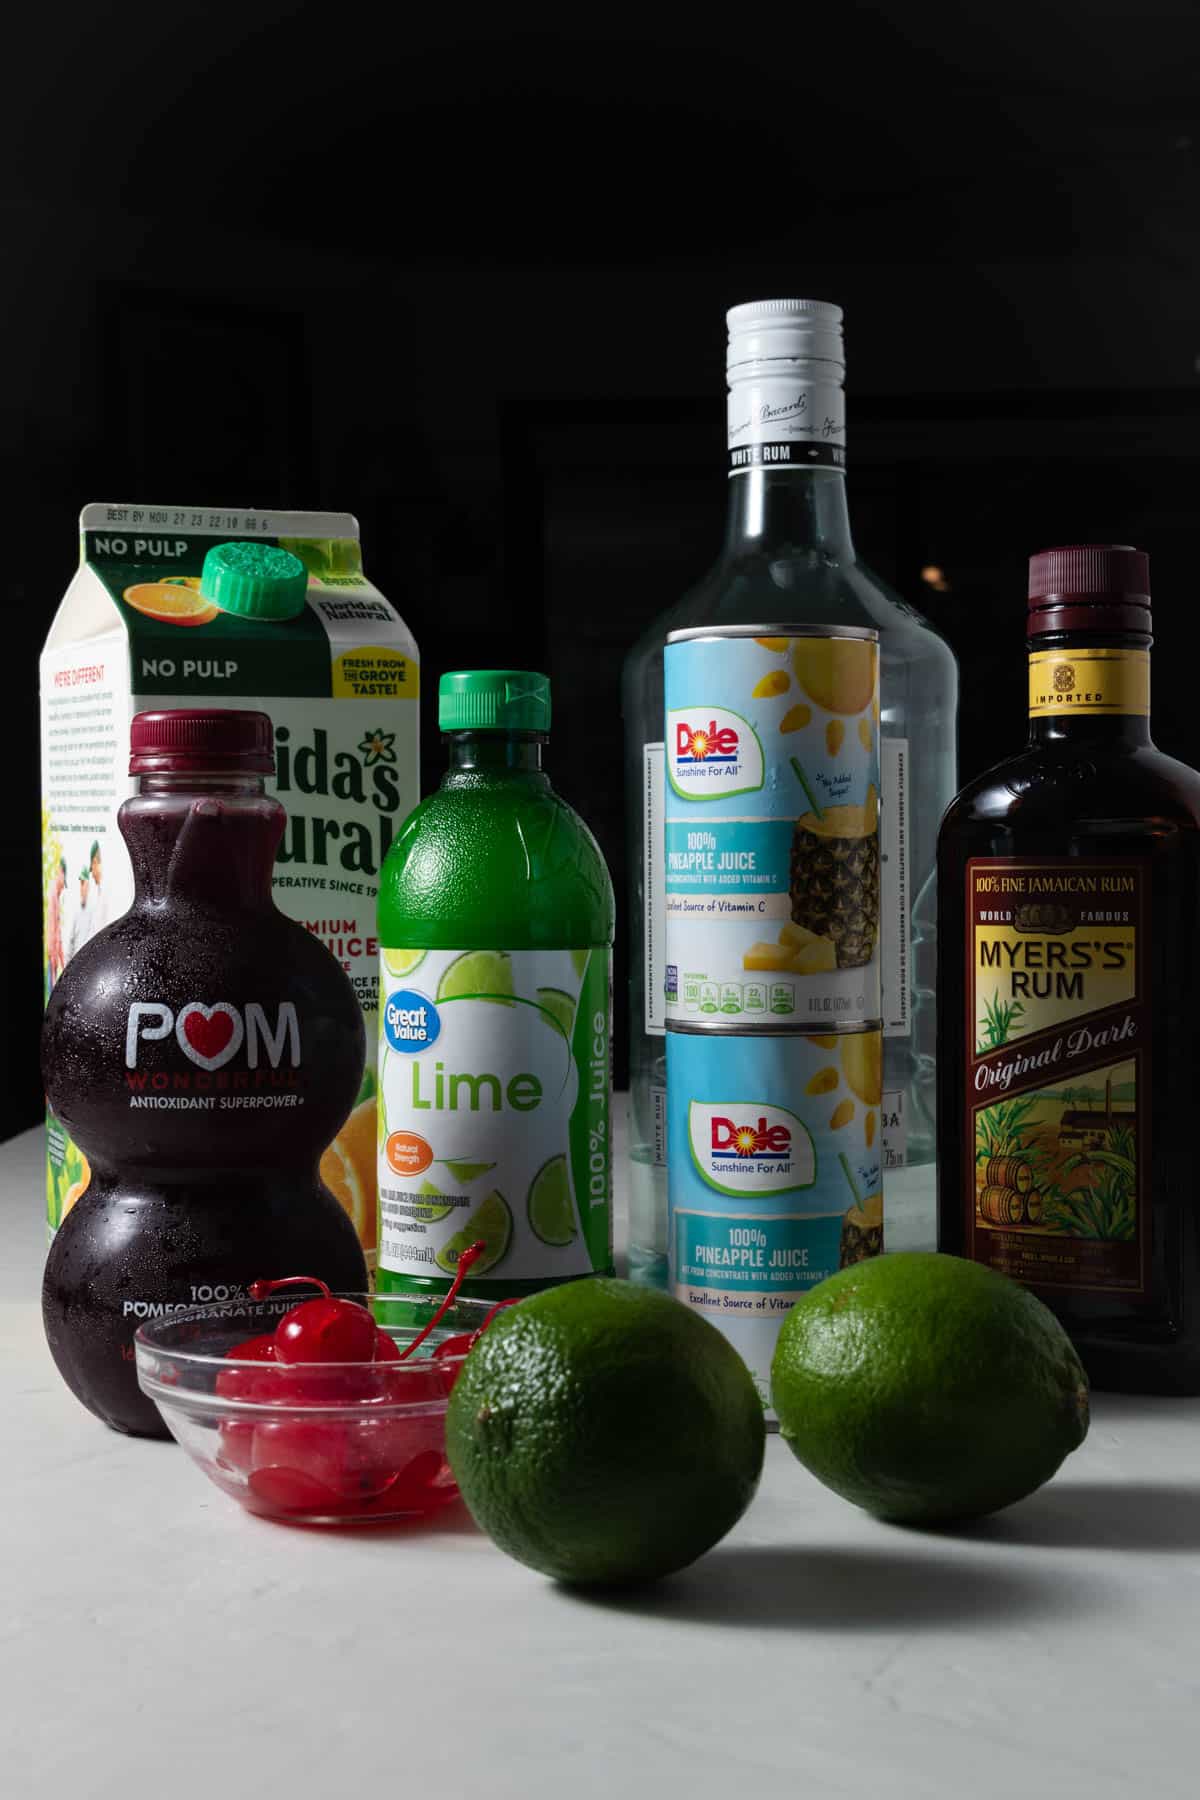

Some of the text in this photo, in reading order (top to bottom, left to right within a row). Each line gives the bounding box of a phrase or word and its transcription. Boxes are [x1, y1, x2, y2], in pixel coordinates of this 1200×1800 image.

[731, 445, 790, 466] WHITE RUM
[107, 509, 128, 521] BEST
[133, 510, 144, 522] BY
[191, 514, 202, 526] 23
[95, 538, 188, 557] NO PULP
[326, 608, 393, 622] Natural
[141, 659, 238, 678] NO PULP
[343, 659, 405, 668] FRESH FROM
[360, 671, 406, 681] GROVE
[352, 683, 398, 695] TASTE!
[1036, 693, 1103, 704] IMPORTED
[677, 720, 739, 757] Dole
[677, 766, 706, 777] Sunshine
[709, 766, 722, 777] For
[275, 815, 393, 876] ural
[688, 831, 716, 850] 100%
[717, 852, 757, 870] JUICE
[272, 877, 378, 897] PERATIVE SINCE 19
[976, 876, 1135, 893] 100% FINE JAMAICAN RUM
[707, 900, 716, 912] of
[717, 900, 755, 912] Vitamin
[758, 901, 767, 912] C
[979, 911, 1129, 921] WORLD FAMOUS
[305, 919, 356, 934] MIUM
[980, 941, 1127, 969] MYERS'S
[1011, 971, 1084, 999] RUM
[387, 1003, 428, 1027] Great
[125, 1001, 301, 1072] POM
[393, 1025, 428, 1041] Value
[974, 1015, 1137, 1091] Original Dark
[125, 1071, 299, 1089] WONDERFUL
[411, 1061, 543, 1111] Lime
[129, 1095, 298, 1110] ANTIOXIDANT SUPERPOWER
[590, 1011, 605, 1209] 100% Juice
[712, 1117, 792, 1154] Dole
[712, 1161, 754, 1173] Sunshine
[757, 1163, 774, 1173] For
[729, 1228, 767, 1247] 100%
[696, 1245, 809, 1267] PINEAPPLE JUICE
[752, 1271, 767, 1281] WITH
[770, 1271, 793, 1281] ADDED
[190, 1284, 246, 1301] 100%
[689, 1291, 721, 1306] Excellent
[723, 1295, 752, 1309] Source
[756, 1297, 767, 1309] of
